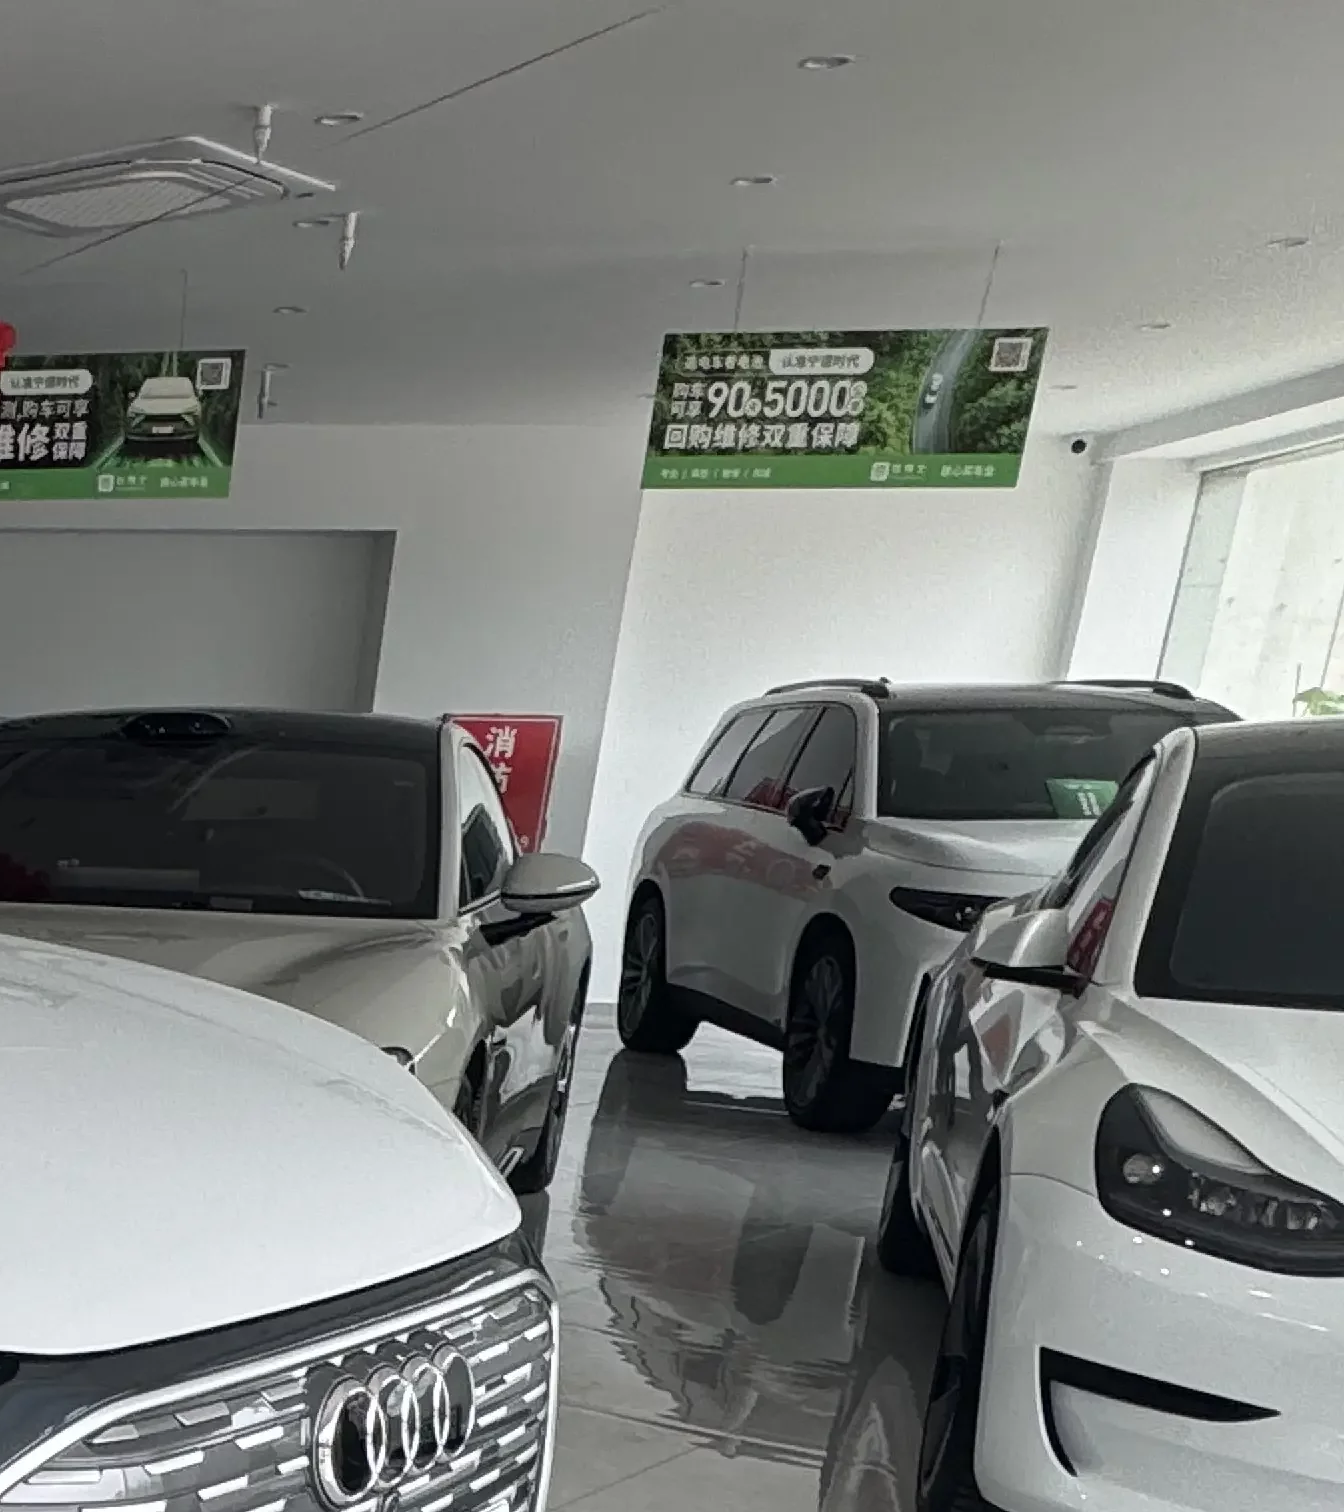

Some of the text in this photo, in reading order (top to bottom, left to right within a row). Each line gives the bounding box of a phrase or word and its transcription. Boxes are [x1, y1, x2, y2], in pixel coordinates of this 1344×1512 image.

[664, 422, 861, 451] 回购维修双重保障
